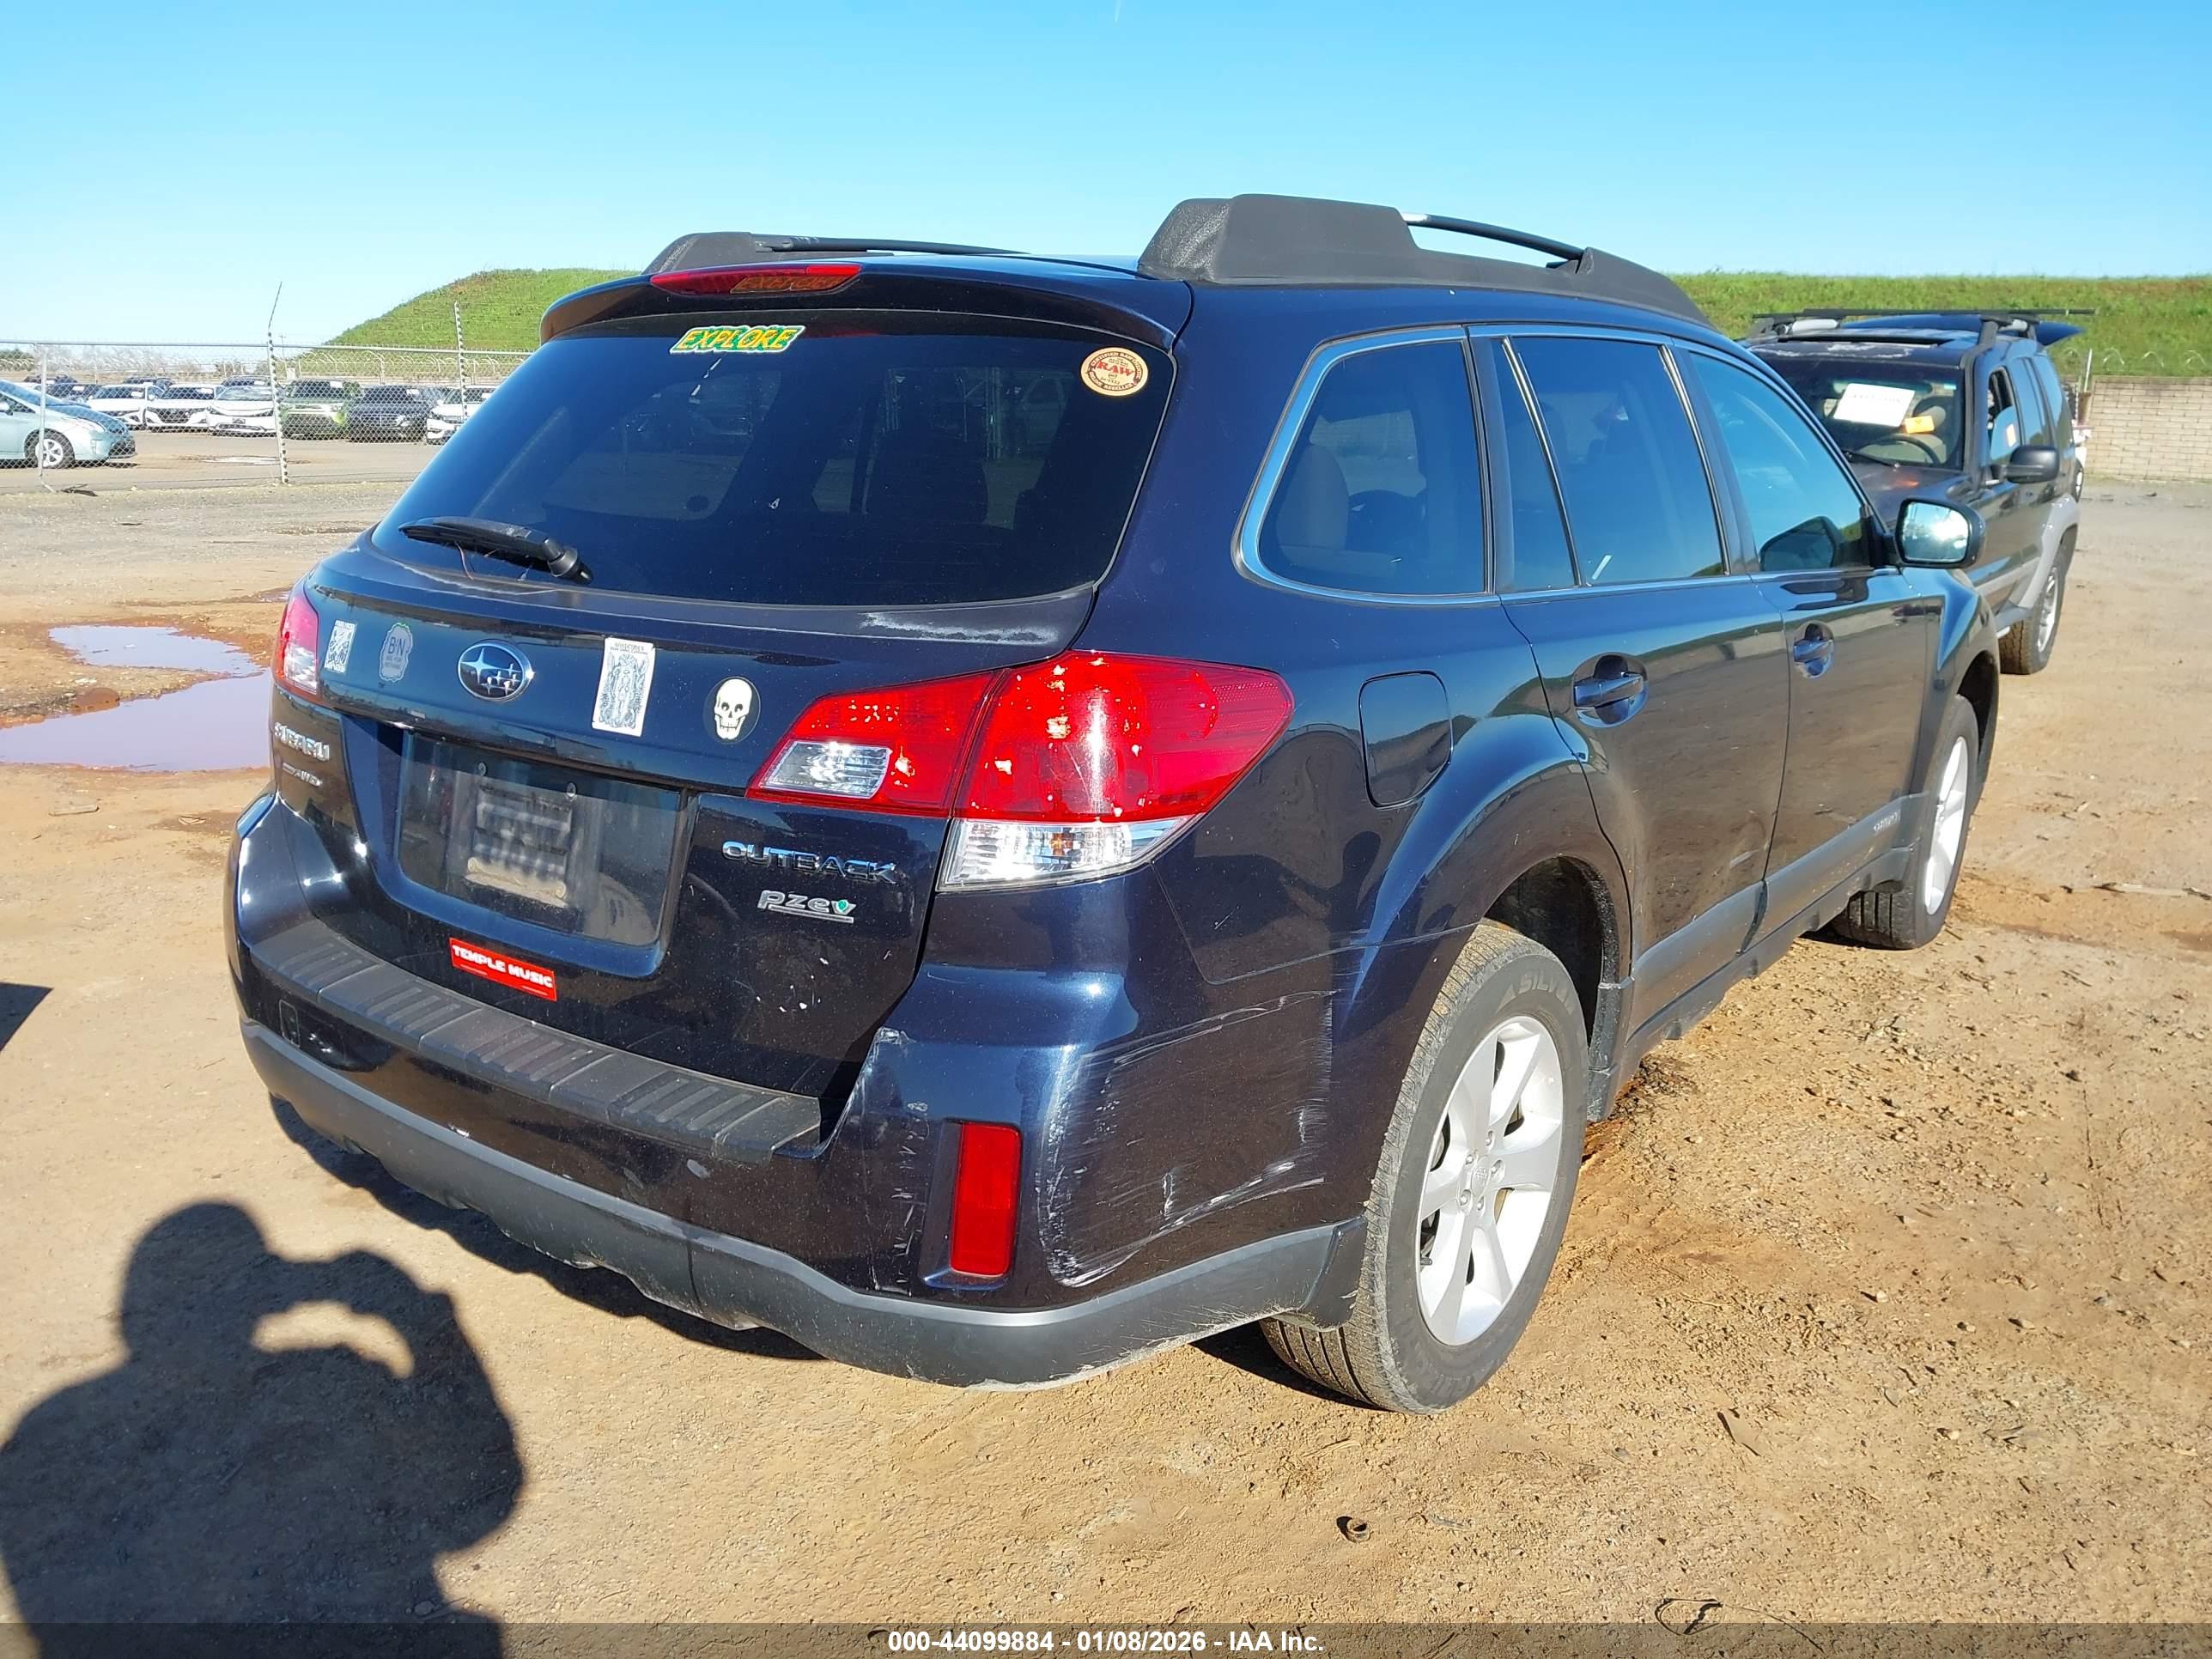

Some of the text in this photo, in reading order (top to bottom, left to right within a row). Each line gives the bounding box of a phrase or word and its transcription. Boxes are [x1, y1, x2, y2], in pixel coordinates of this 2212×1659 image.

[675, 327, 800, 350] EXPLORE
[1097, 362, 1135, 377] RAW
[275, 722, 330, 762] SUBARU
[722, 841, 896, 884] OUTBACK
[452, 945, 554, 988] TEMPLE MUSIC
